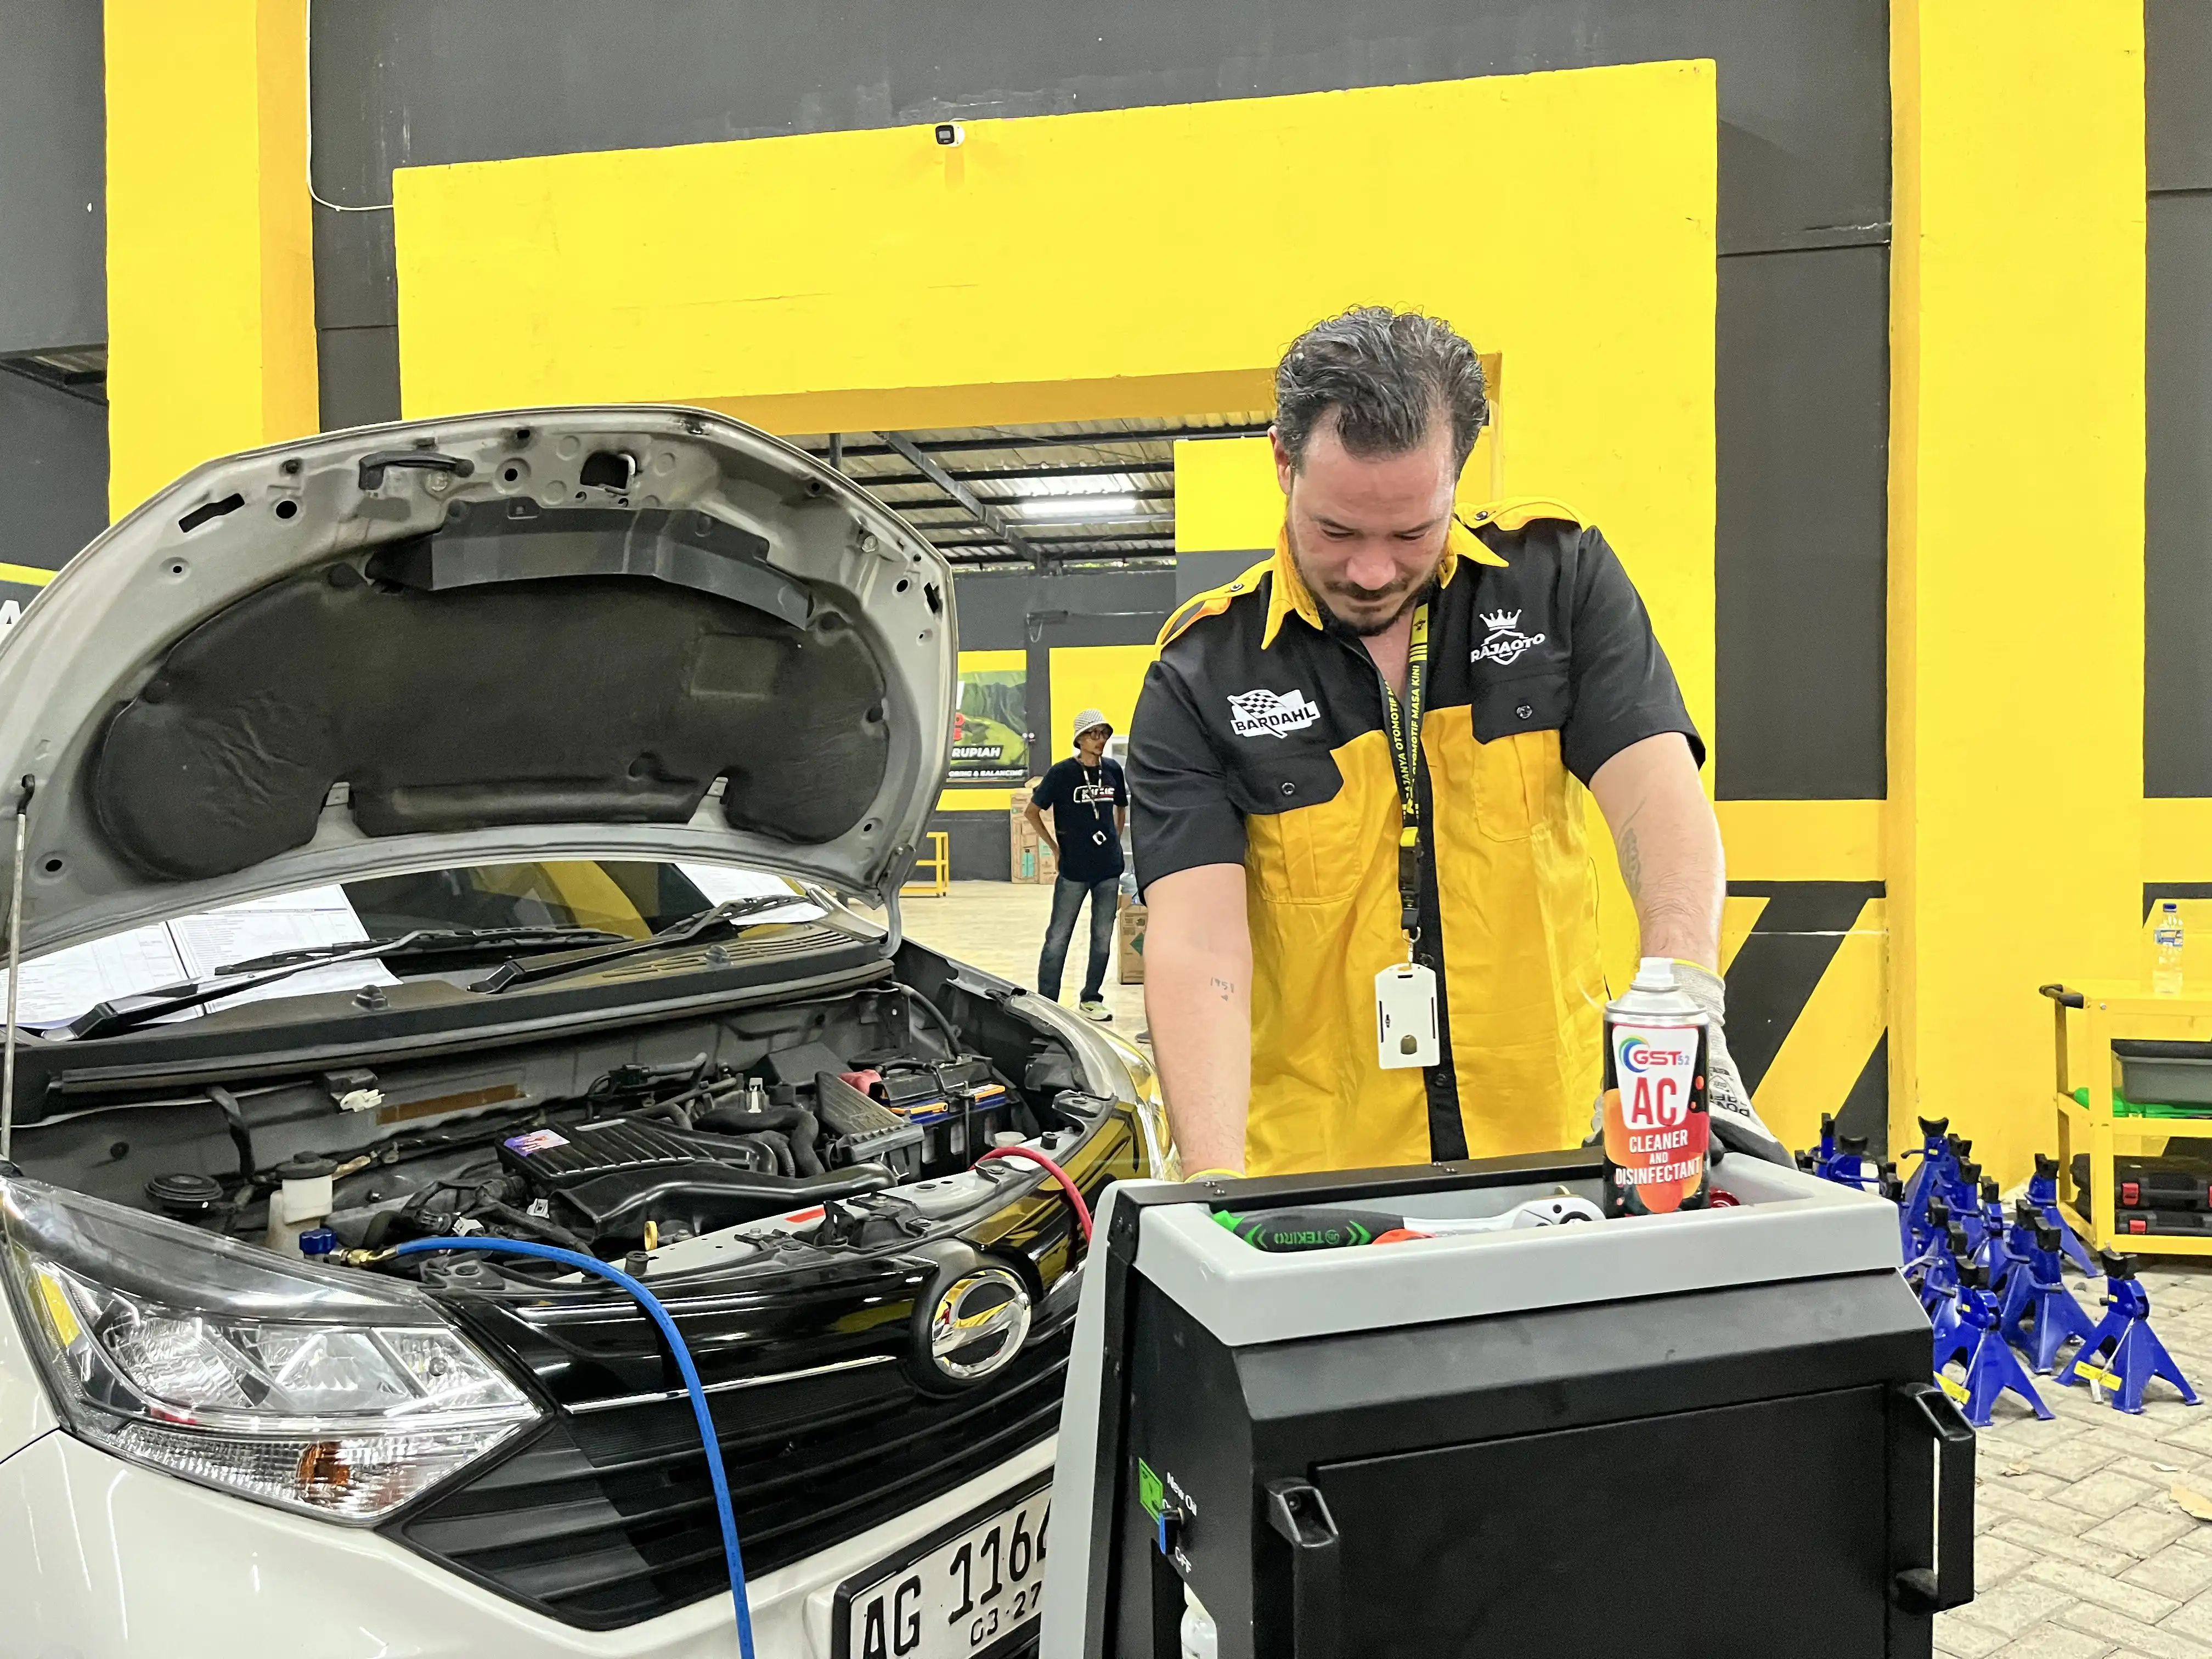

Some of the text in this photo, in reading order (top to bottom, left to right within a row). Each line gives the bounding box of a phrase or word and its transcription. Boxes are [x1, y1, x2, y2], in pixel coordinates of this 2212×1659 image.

[1470, 633, 1546, 663] RAJAOTO
[1412, 665, 1420, 686] KINI
[1411, 689, 1420, 719] MASA
[1234, 707, 1316, 731] BARDAHL
[1389, 697, 1404, 751] OTOMOTIF
[952, 747, 1001, 758] RUPIAH
[1398, 753, 1410, 798] AJANYA
[1631, 1076, 1677, 1126] AC
[1629, 1129, 1688, 1153] CLEANER
[1615, 1156, 1701, 1185] DISINFECTANT
[1649, 1152, 1668, 1165] AND
[862, 1574, 922, 1659] AG
